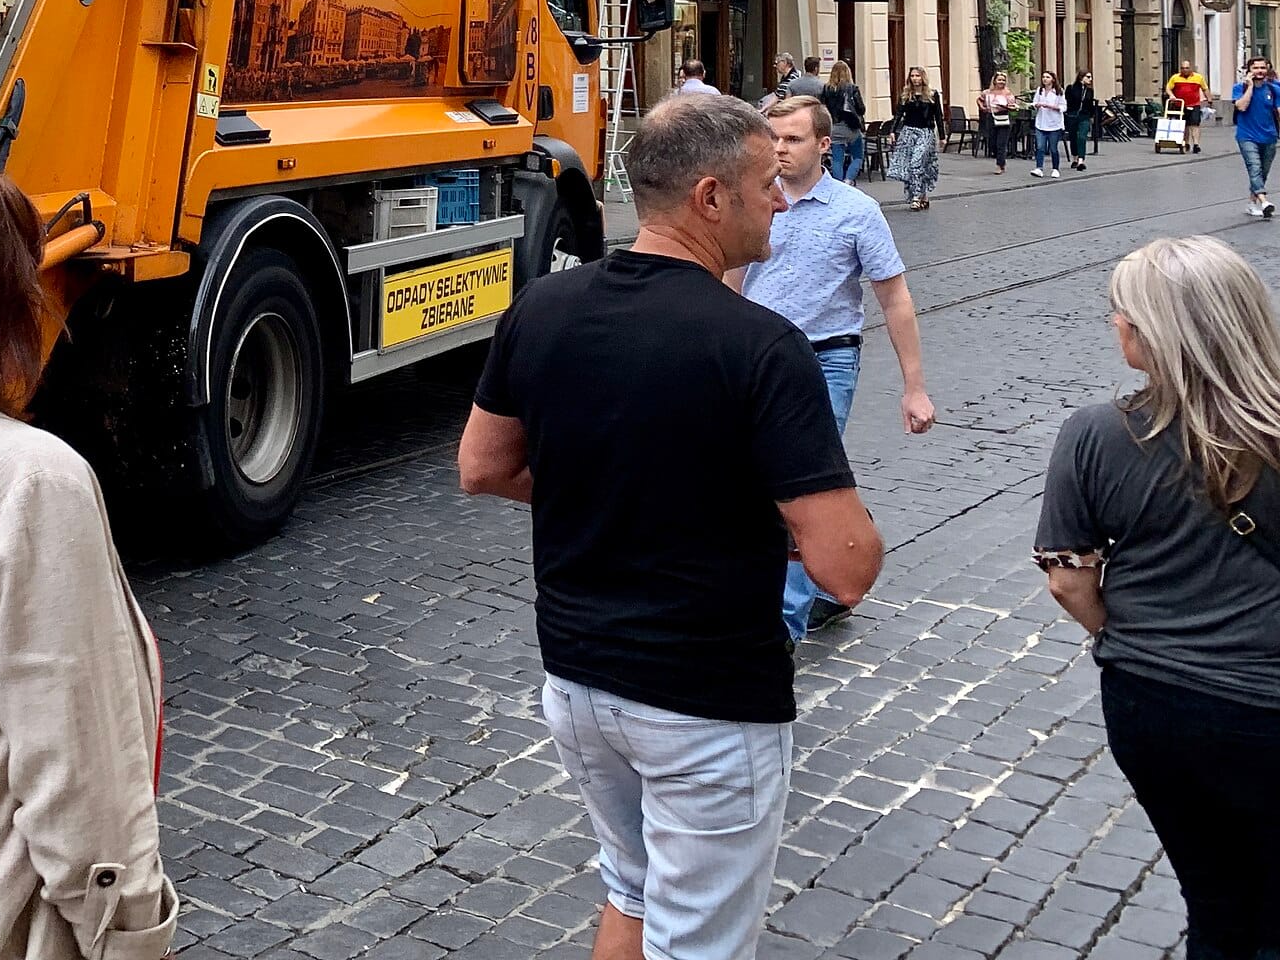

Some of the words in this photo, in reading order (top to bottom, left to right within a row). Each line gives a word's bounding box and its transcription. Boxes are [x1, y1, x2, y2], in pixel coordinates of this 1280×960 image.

[386, 280, 436, 314] ODPADY
[436, 262, 509, 300] SELEKTYWNIE
[420, 294, 475, 330] ZBIERANE
